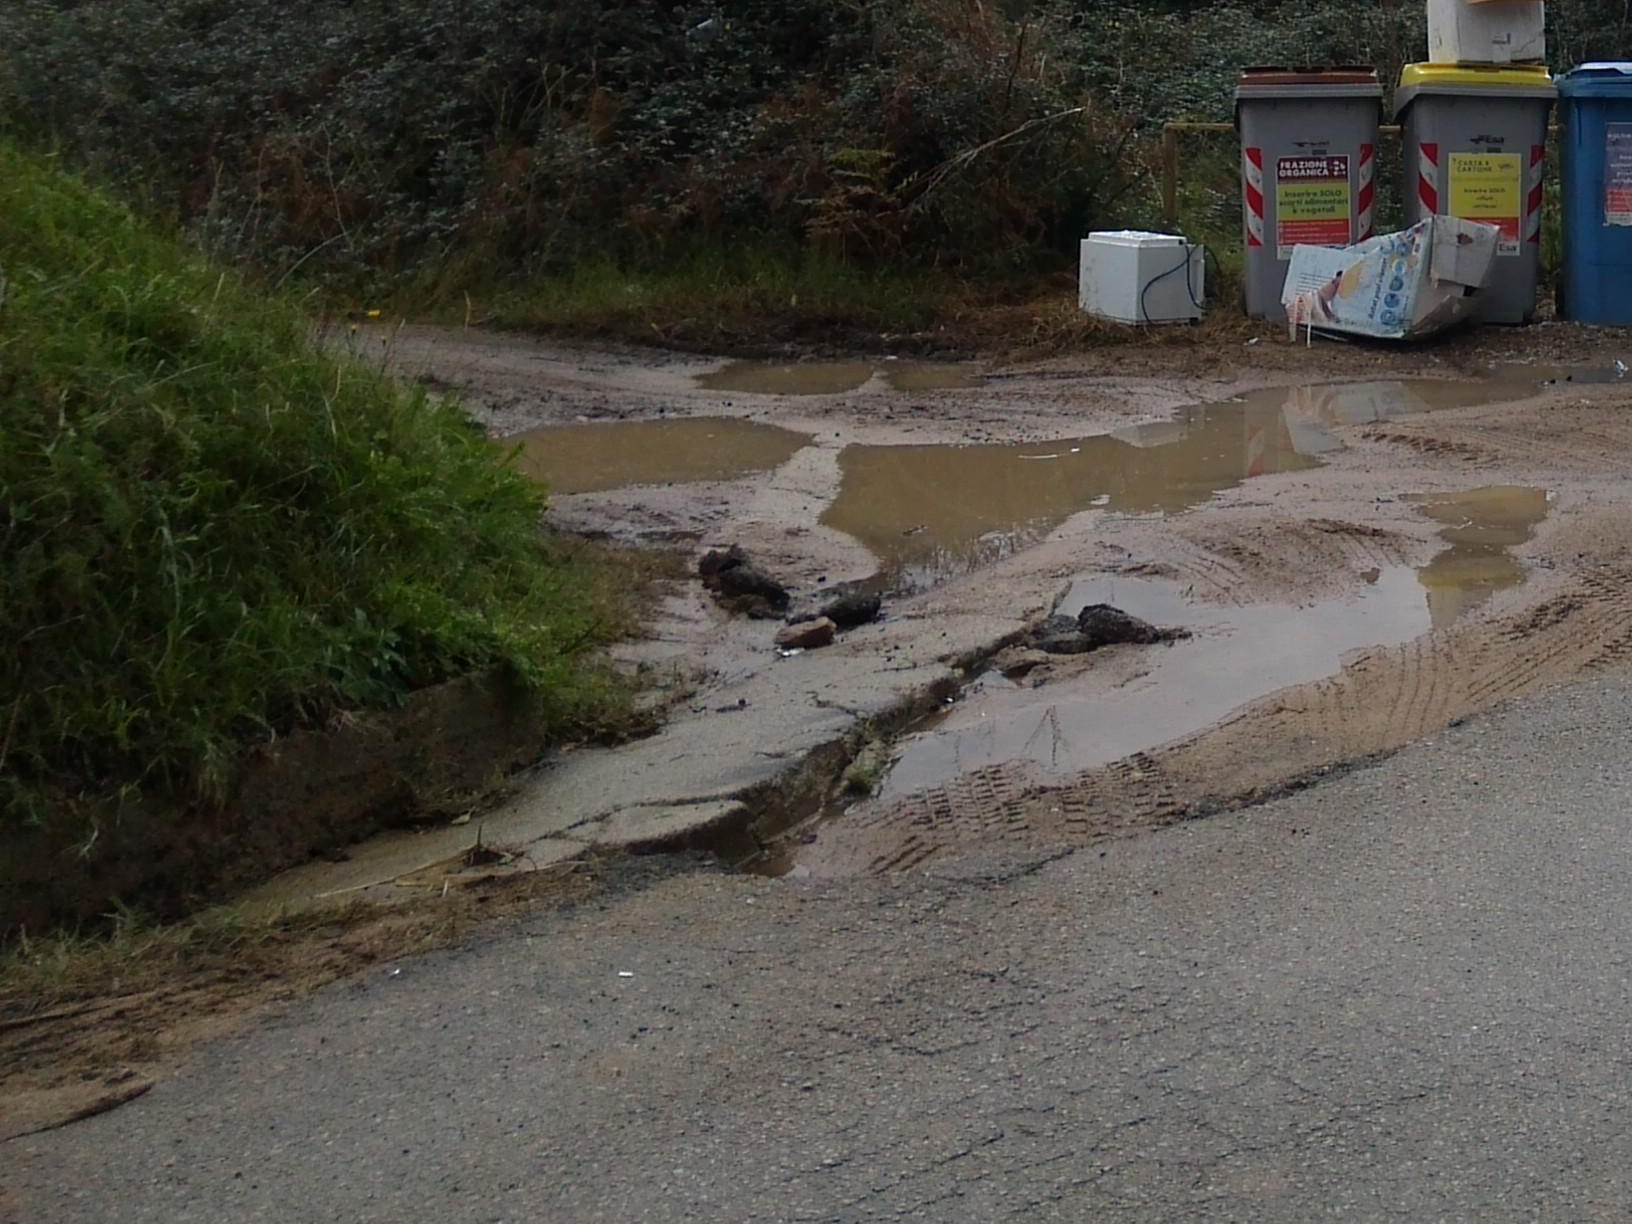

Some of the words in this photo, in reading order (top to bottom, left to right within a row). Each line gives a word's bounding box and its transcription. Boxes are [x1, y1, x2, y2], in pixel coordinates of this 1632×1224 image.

[1280, 161, 1327, 169] FRAZIONE
[1279, 169, 1329, 177] ORGANICA
[1320, 189, 1342, 197] SOLO
